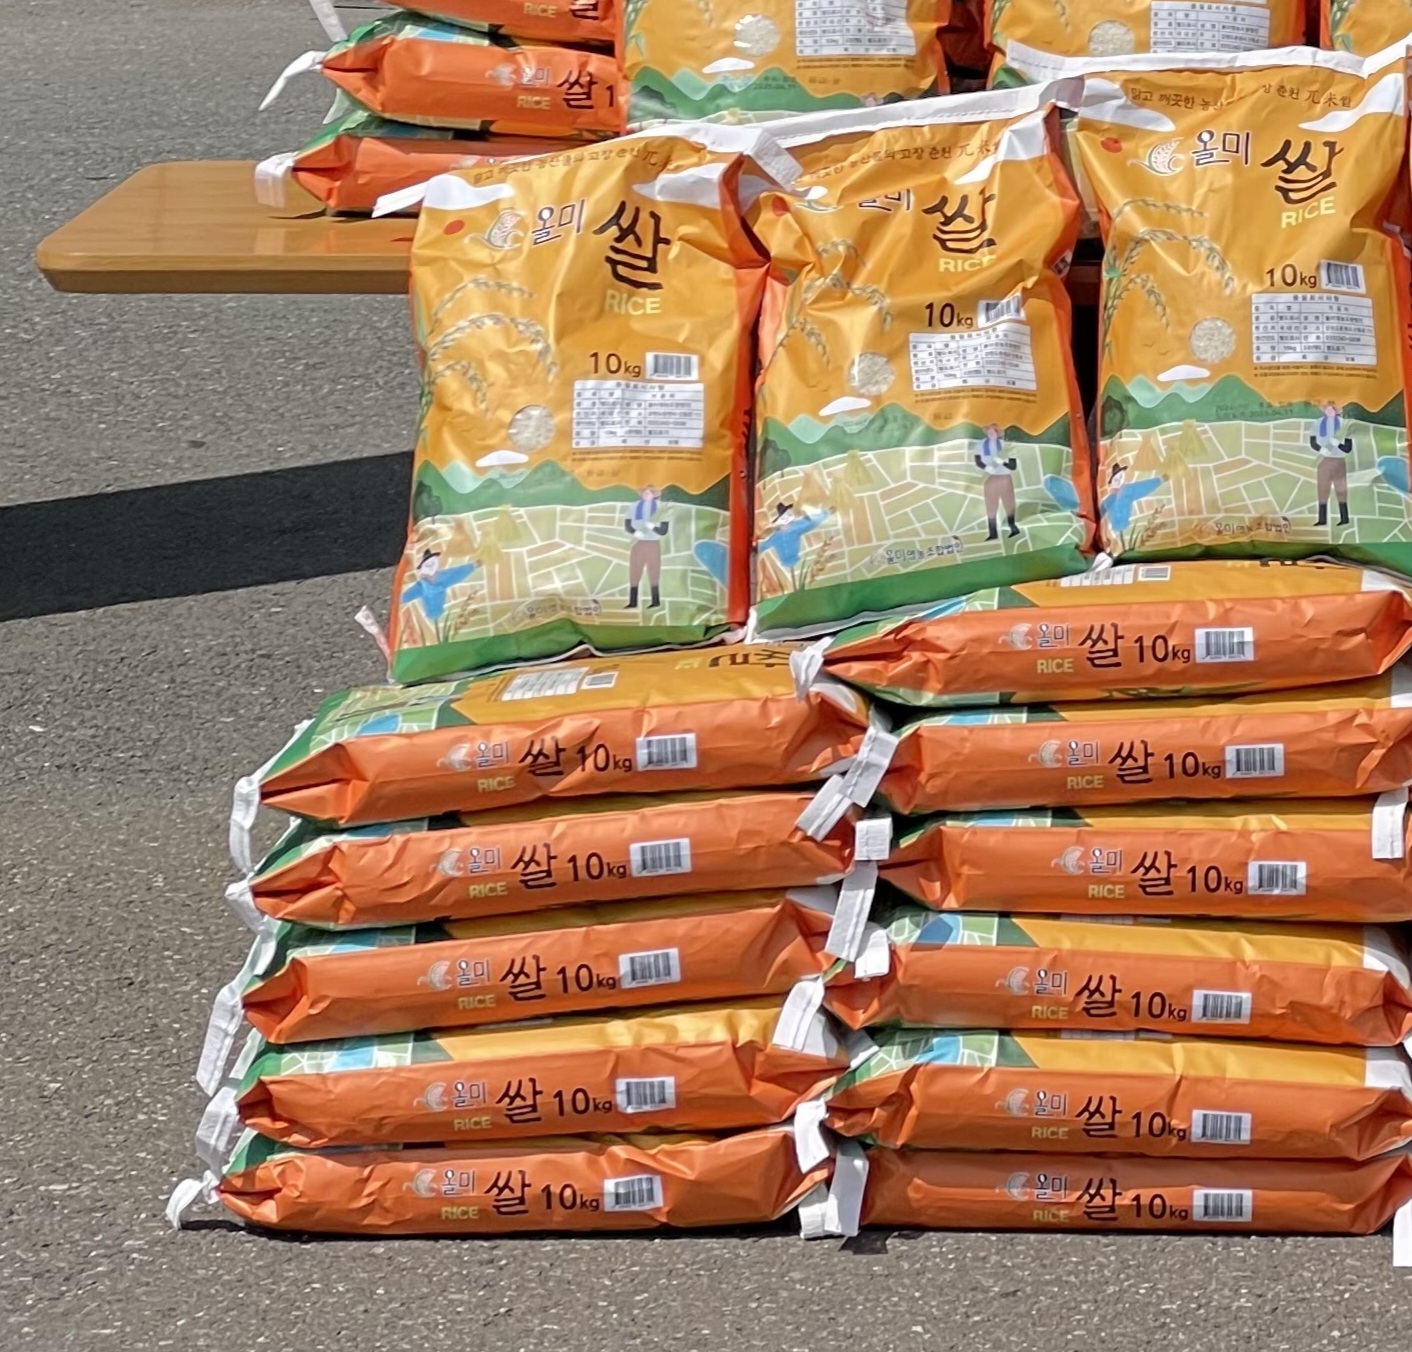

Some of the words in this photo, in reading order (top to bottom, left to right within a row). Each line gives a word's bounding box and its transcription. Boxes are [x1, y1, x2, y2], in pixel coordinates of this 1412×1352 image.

[524, 3, 557, 18] RICE
[557, 69, 598, 109] 쌀
[517, 96, 551, 110] RICE
[1192, 129, 1251, 167] 올미
[1261, 139, 1343, 204] 쌀
[1281, 196, 1335, 229] RICE
[531, 200, 585, 246] 올미
[593, 201, 670, 291] 쌀
[1266, 263, 1317, 288] 10kg
[604, 288, 661, 316] RICE
[924, 302, 973, 329] 10kg
[589, 352, 641, 378] 10kg
[1036, 623, 1070, 648] 올미
[1078, 622, 1124, 668] 쌀
[1134, 634, 1190, 663] 10kg
[1037, 659, 1073, 673] RICE
[476, 742, 509, 767] 올미
[519, 736, 566, 776] 쌀
[577, 743, 632, 772] 10kg
[1067, 740, 1099, 766] 올미
[1109, 739, 1154, 783] 쌀
[1164, 752, 1221, 778] 10kg
[477, 776, 515, 792] RICE
[1067, 776, 1104, 789] RICE
[1089, 848, 1123, 874] 올미
[1130, 850, 1177, 896] 쌀
[1186, 865, 1243, 894] 10kg
[1088, 885, 1124, 898] RICE
[456, 959, 490, 986] 올미
[500, 954, 547, 1001] 쌀
[557, 964, 616, 993] 10kg
[458, 994, 496, 1010] RICE
[453, 1081, 486, 1108] 올미
[496, 1077, 543, 1123] 쌀
[553, 1087, 612, 1116] 10kg
[454, 1116, 492, 1131] RICE
[1034, 1090, 1068, 1117] 올미
[1075, 1095, 1122, 1138] 쌀
[1131, 1112, 1187, 1141] 10kg
[1031, 1127, 1069, 1139] RICE
